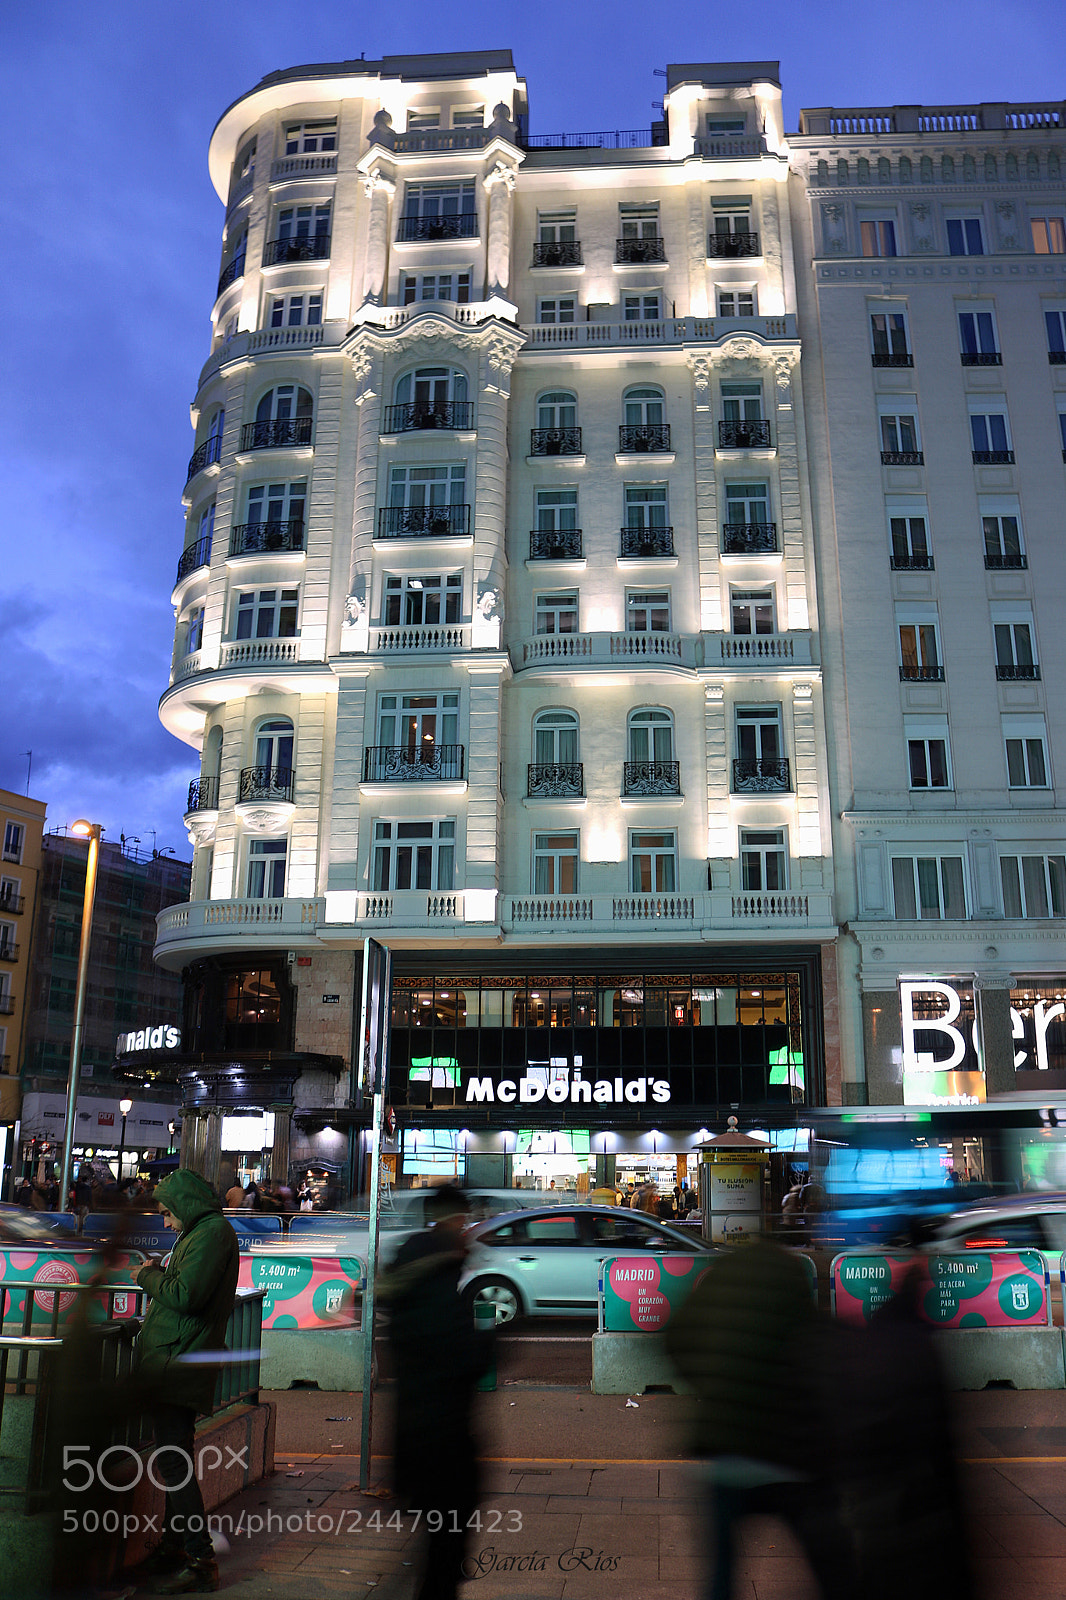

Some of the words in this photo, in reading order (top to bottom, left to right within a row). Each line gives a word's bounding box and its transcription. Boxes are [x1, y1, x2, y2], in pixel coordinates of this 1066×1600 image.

[116, 1024, 180, 1058] nald's
[466, 1077, 671, 1103] McDonald's
[125, 1237, 159, 1246] ADRID
[238, 1238, 262, 1247] DRID
[259, 1264, 286, 1277] 5.400
[846, 1267, 885, 1279] MADRID
[938, 1262, 964, 1275] 5.400
[615, 1269, 655, 1281] MADRID
[266, 1282, 283, 1290] ACERA
[947, 1280, 966, 1288] ACERA
[940, 1288, 952, 1298] MÁS
[638, 1296, 664, 1304] CORAZÓN
[940, 1299, 956, 1307] PARA
[638, 1306, 651, 1314] MUY
